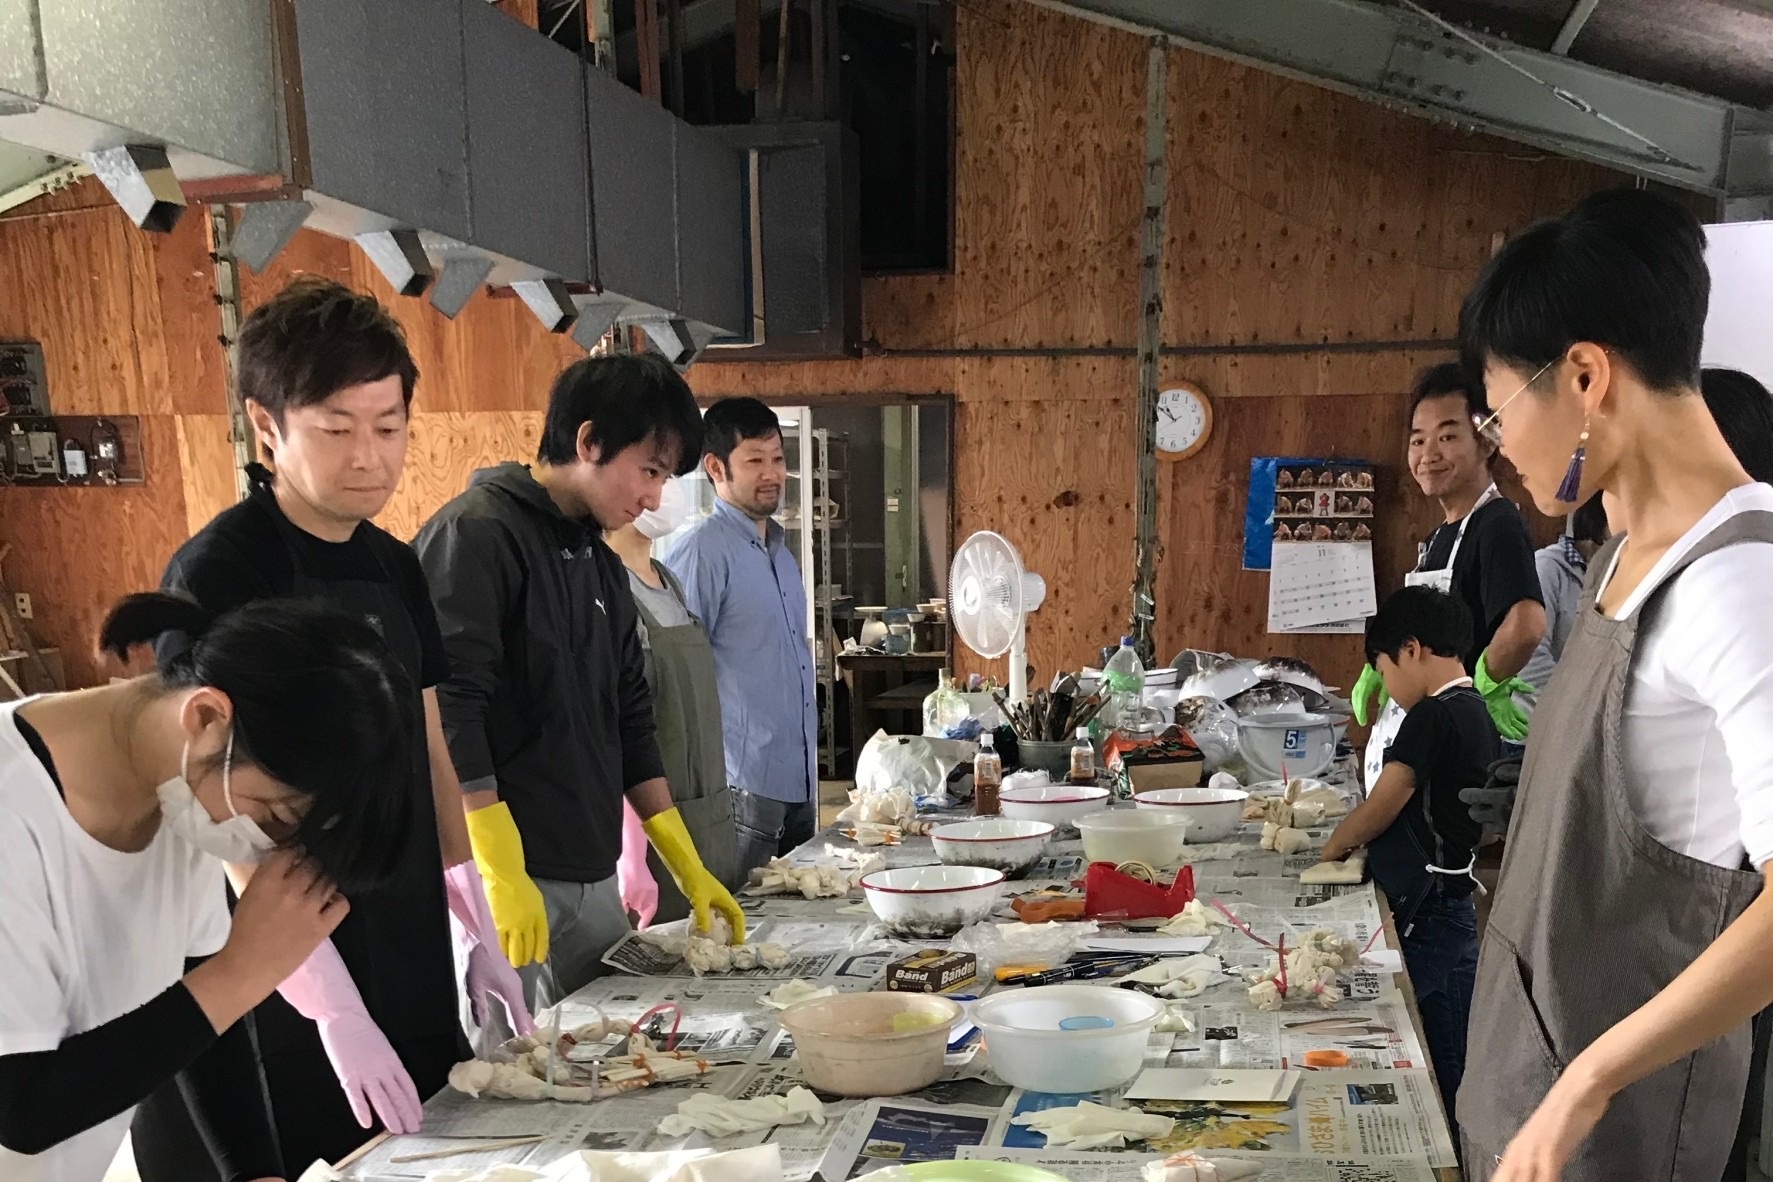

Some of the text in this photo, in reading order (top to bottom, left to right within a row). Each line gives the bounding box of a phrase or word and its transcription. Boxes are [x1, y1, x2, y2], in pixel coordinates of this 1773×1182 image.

[1285, 730, 1297, 749] 5
[895, 969, 929, 981] Band
[941, 965, 967, 985] Band
